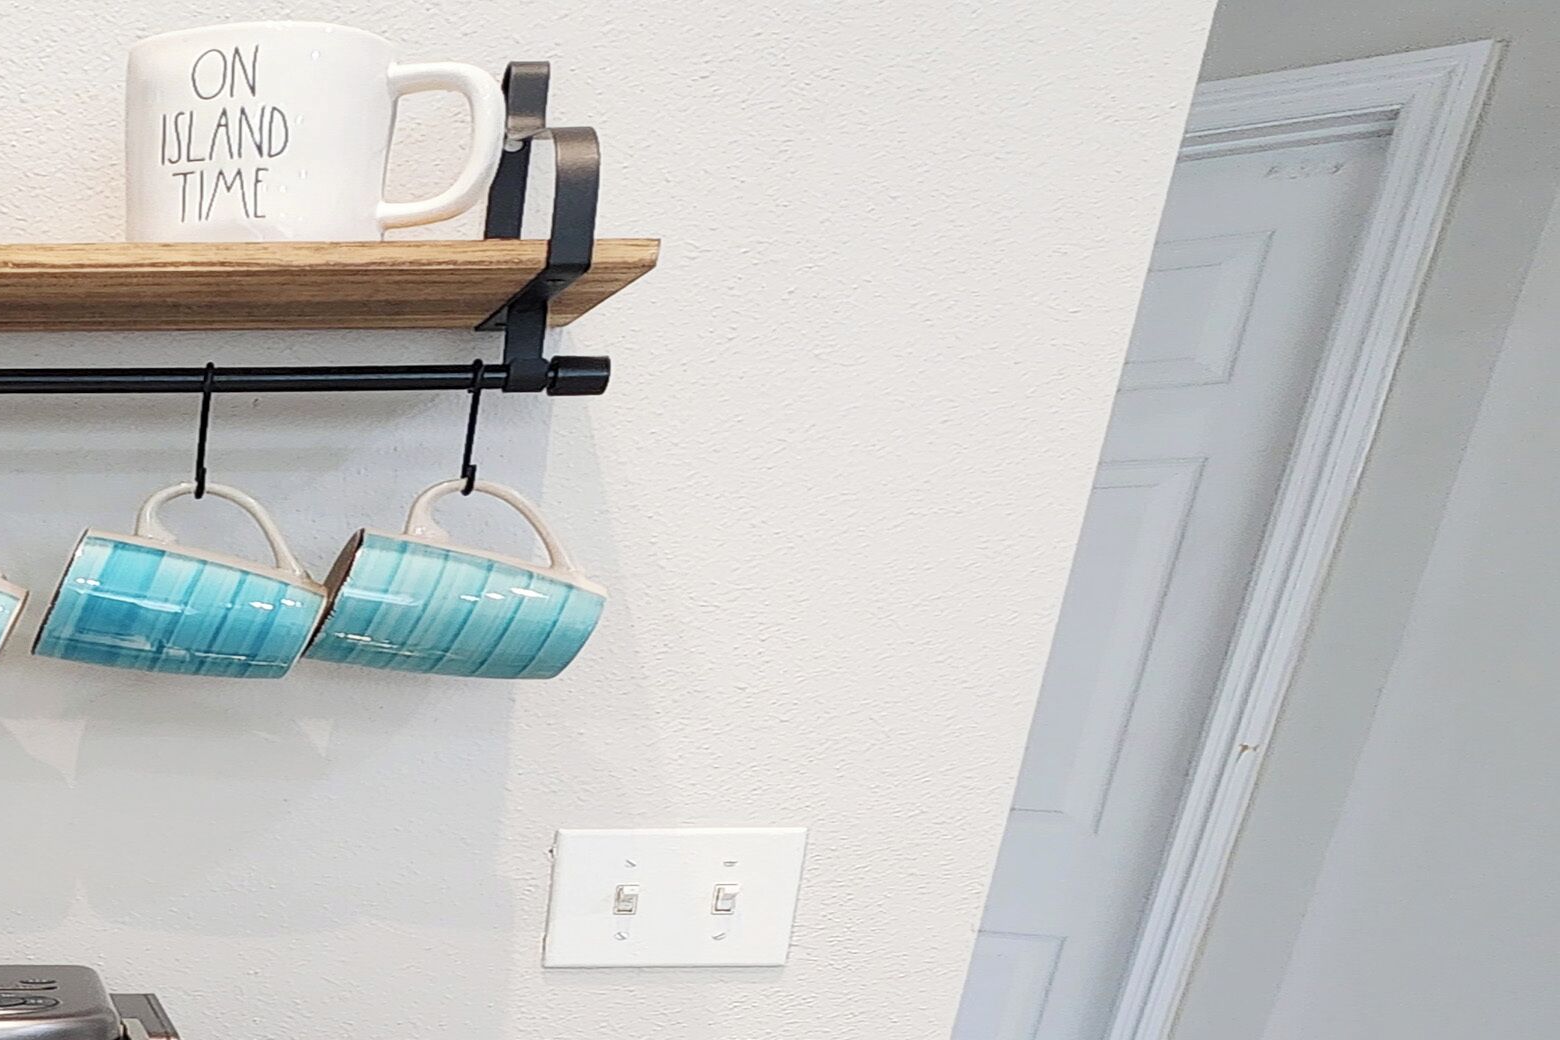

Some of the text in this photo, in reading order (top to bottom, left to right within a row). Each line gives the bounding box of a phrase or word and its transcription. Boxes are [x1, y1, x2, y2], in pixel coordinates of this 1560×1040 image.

[192, 45, 259, 100] ON
[161, 105, 289, 166] ISLAND
[172, 168, 269, 222] TIME
